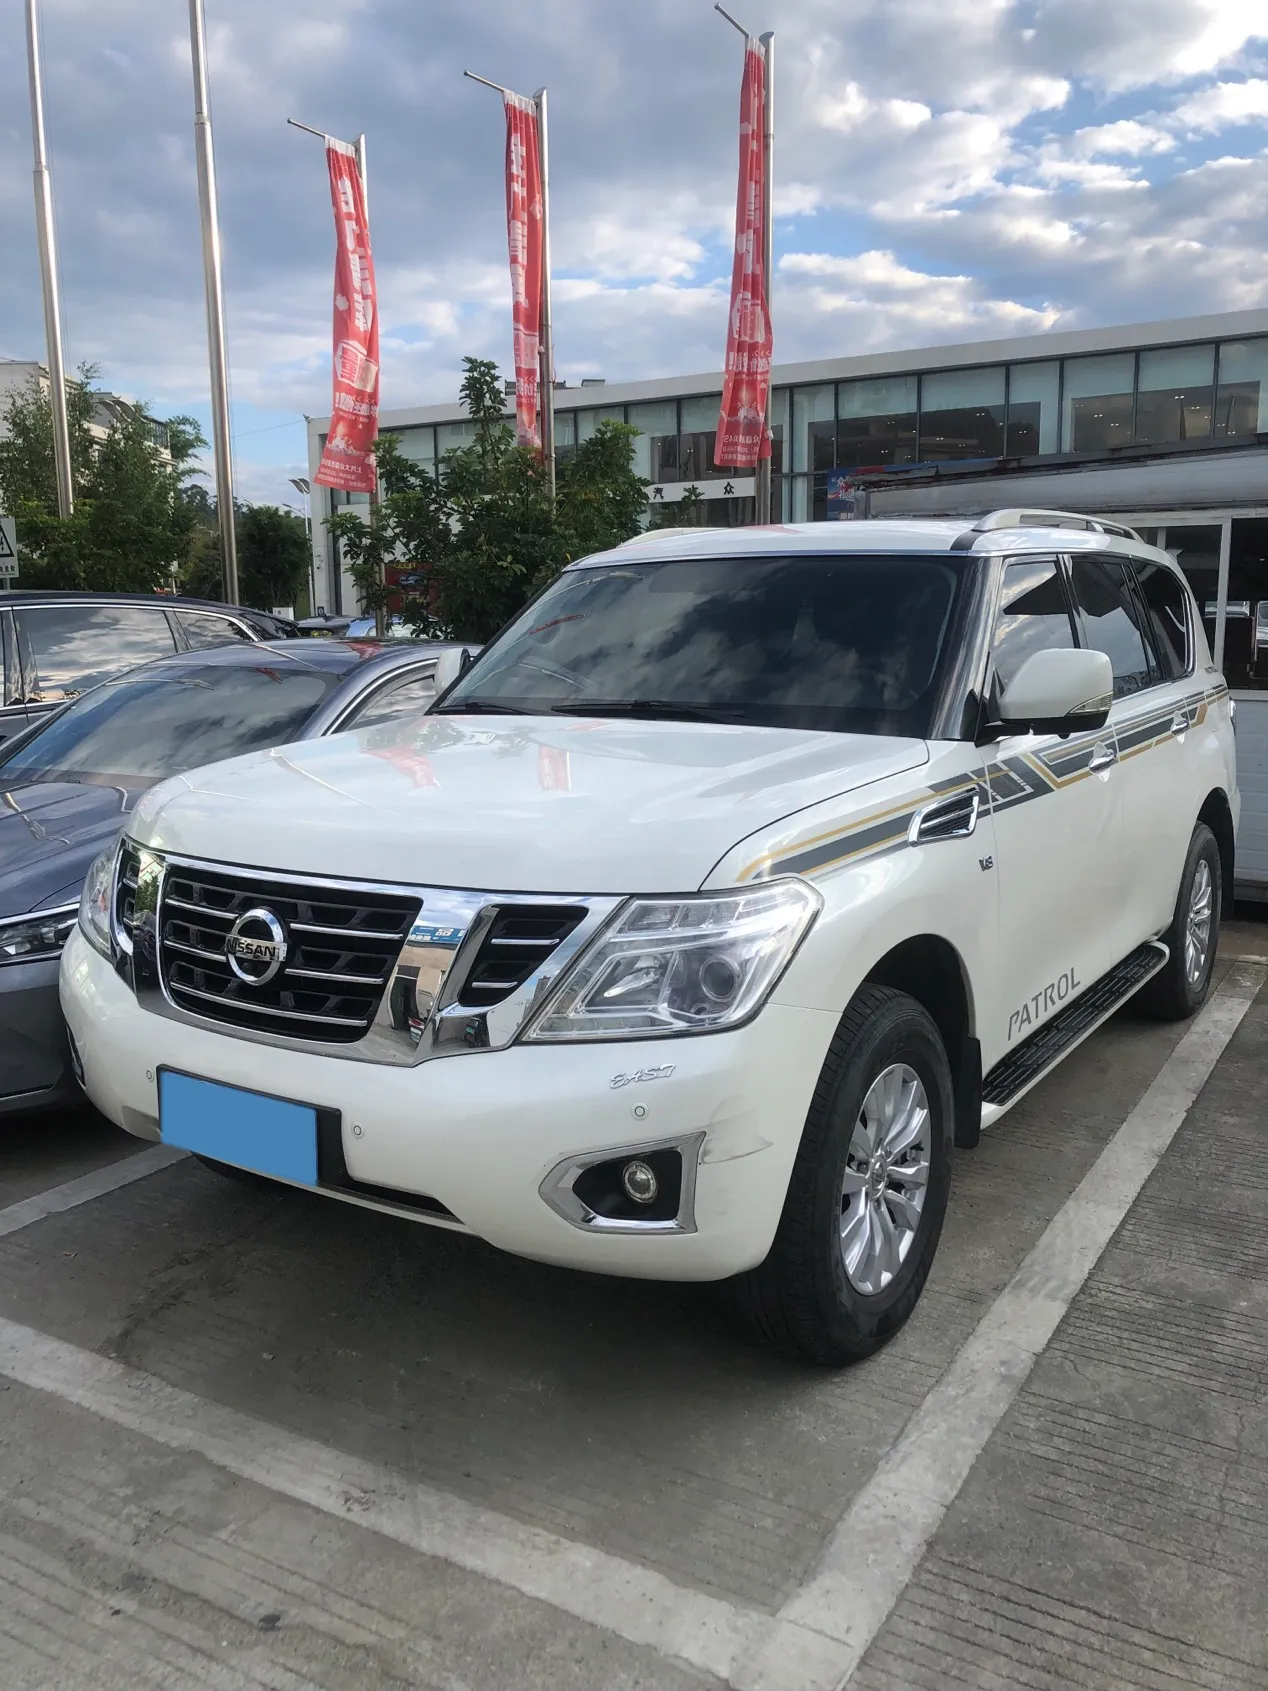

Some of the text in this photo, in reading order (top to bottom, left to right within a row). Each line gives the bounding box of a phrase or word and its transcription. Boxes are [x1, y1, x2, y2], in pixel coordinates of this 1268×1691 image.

[227, 937, 277, 958] NISSAN
[1008, 967, 1081, 1041] PATROL
[609, 1063, 676, 1089] EAST
